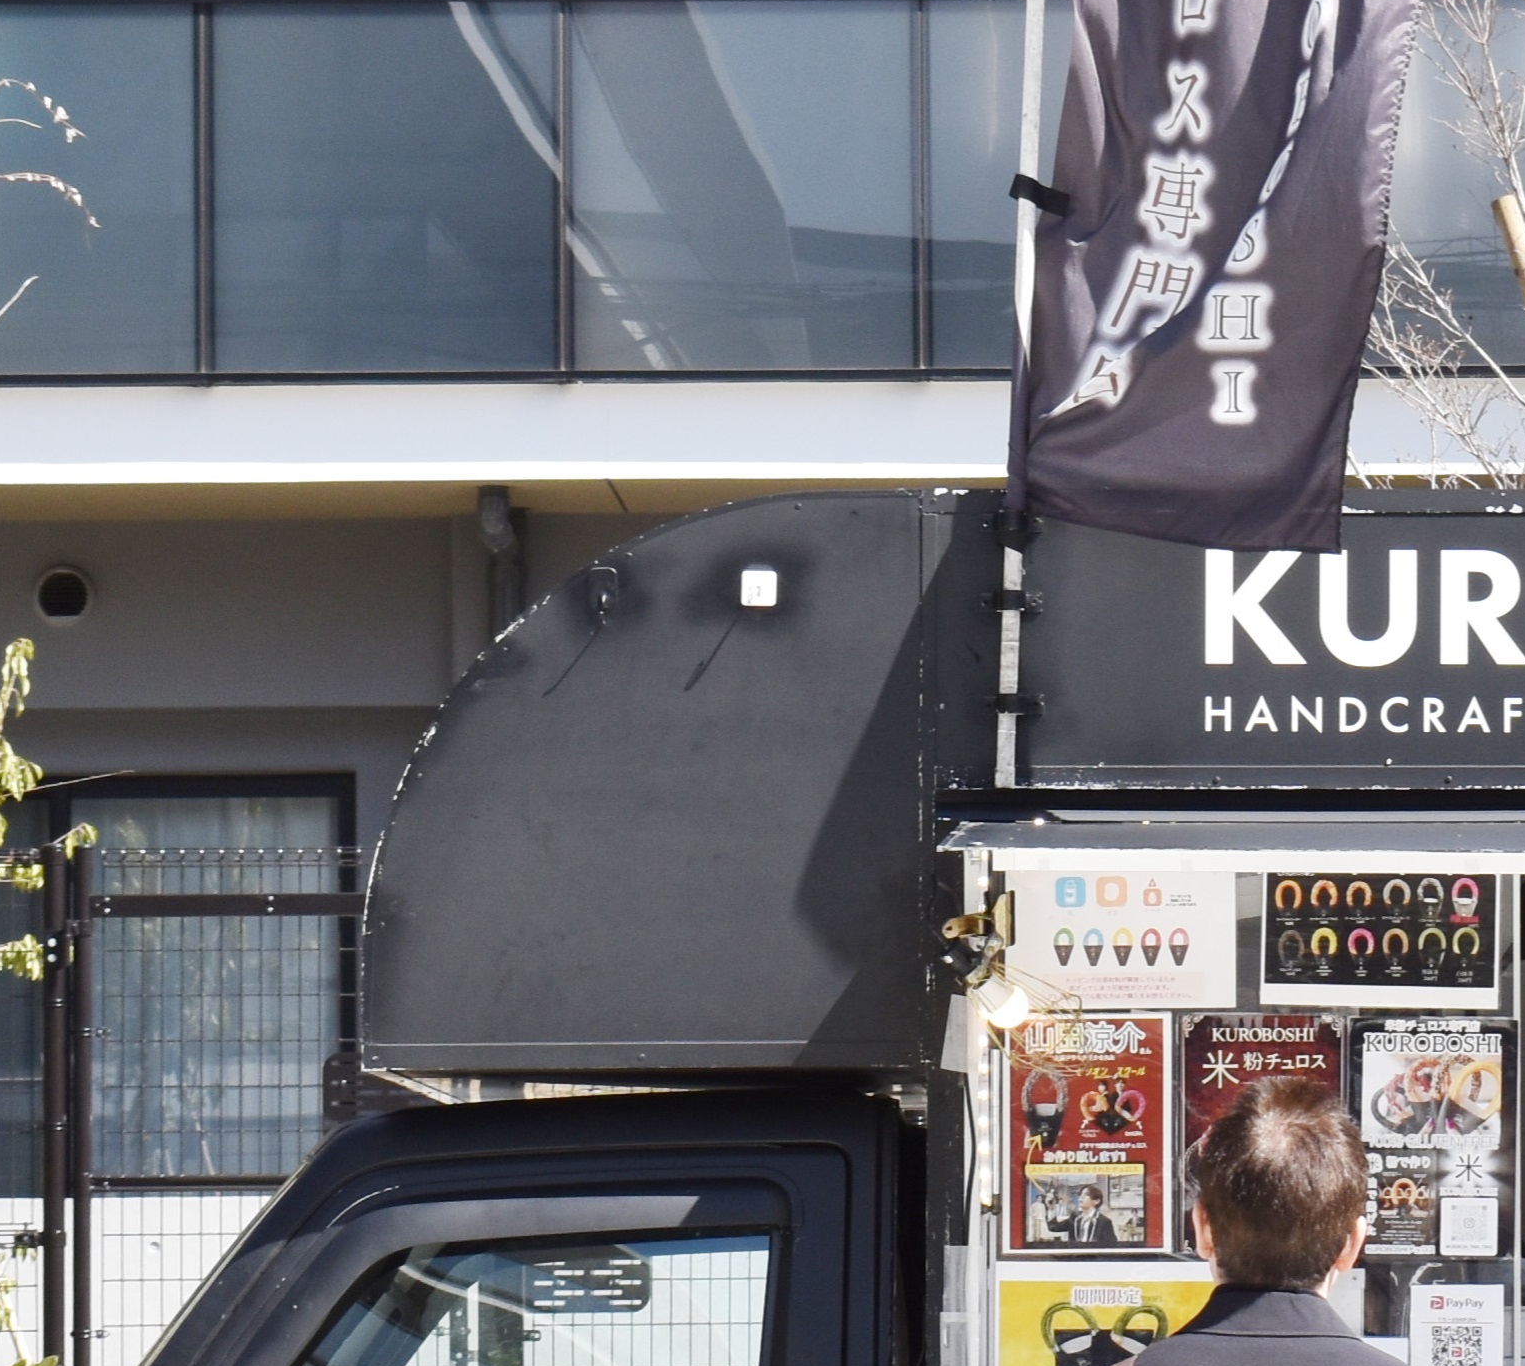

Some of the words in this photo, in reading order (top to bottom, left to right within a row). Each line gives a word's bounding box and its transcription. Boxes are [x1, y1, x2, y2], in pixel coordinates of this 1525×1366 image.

[1211, 1027, 1315, 1042] KUROBOSHI
[1364, 1034, 1502, 1053] KUROBOSHI
[1201, 1050, 1240, 1088] 米
[1243, 1052, 1327, 1072] 粉チュロス
[1455, 1154, 1483, 1181] 米
[1446, 1298, 1484, 1309] PayPay
